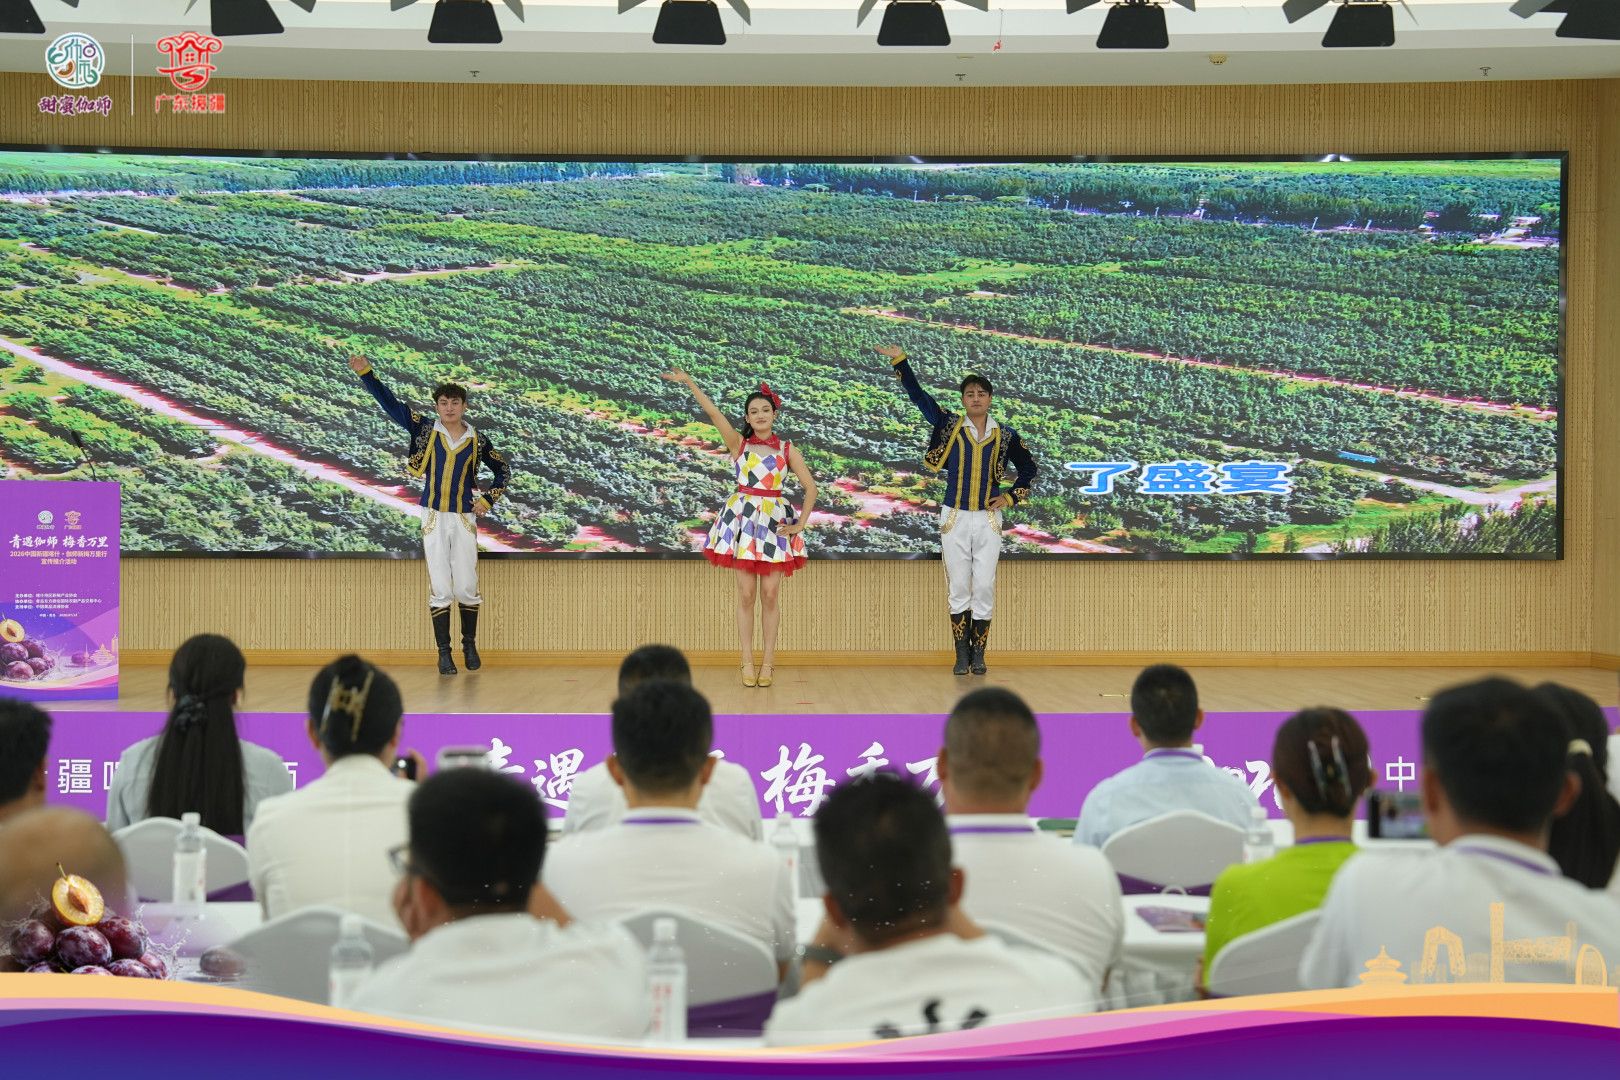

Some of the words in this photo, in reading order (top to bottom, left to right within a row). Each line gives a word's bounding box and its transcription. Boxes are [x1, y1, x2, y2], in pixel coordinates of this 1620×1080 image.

[1064, 460, 1293, 495] 了盛宴
[9, 534, 58, 549] 青遇伽师
[62, 535, 109, 548] 梅香万里
